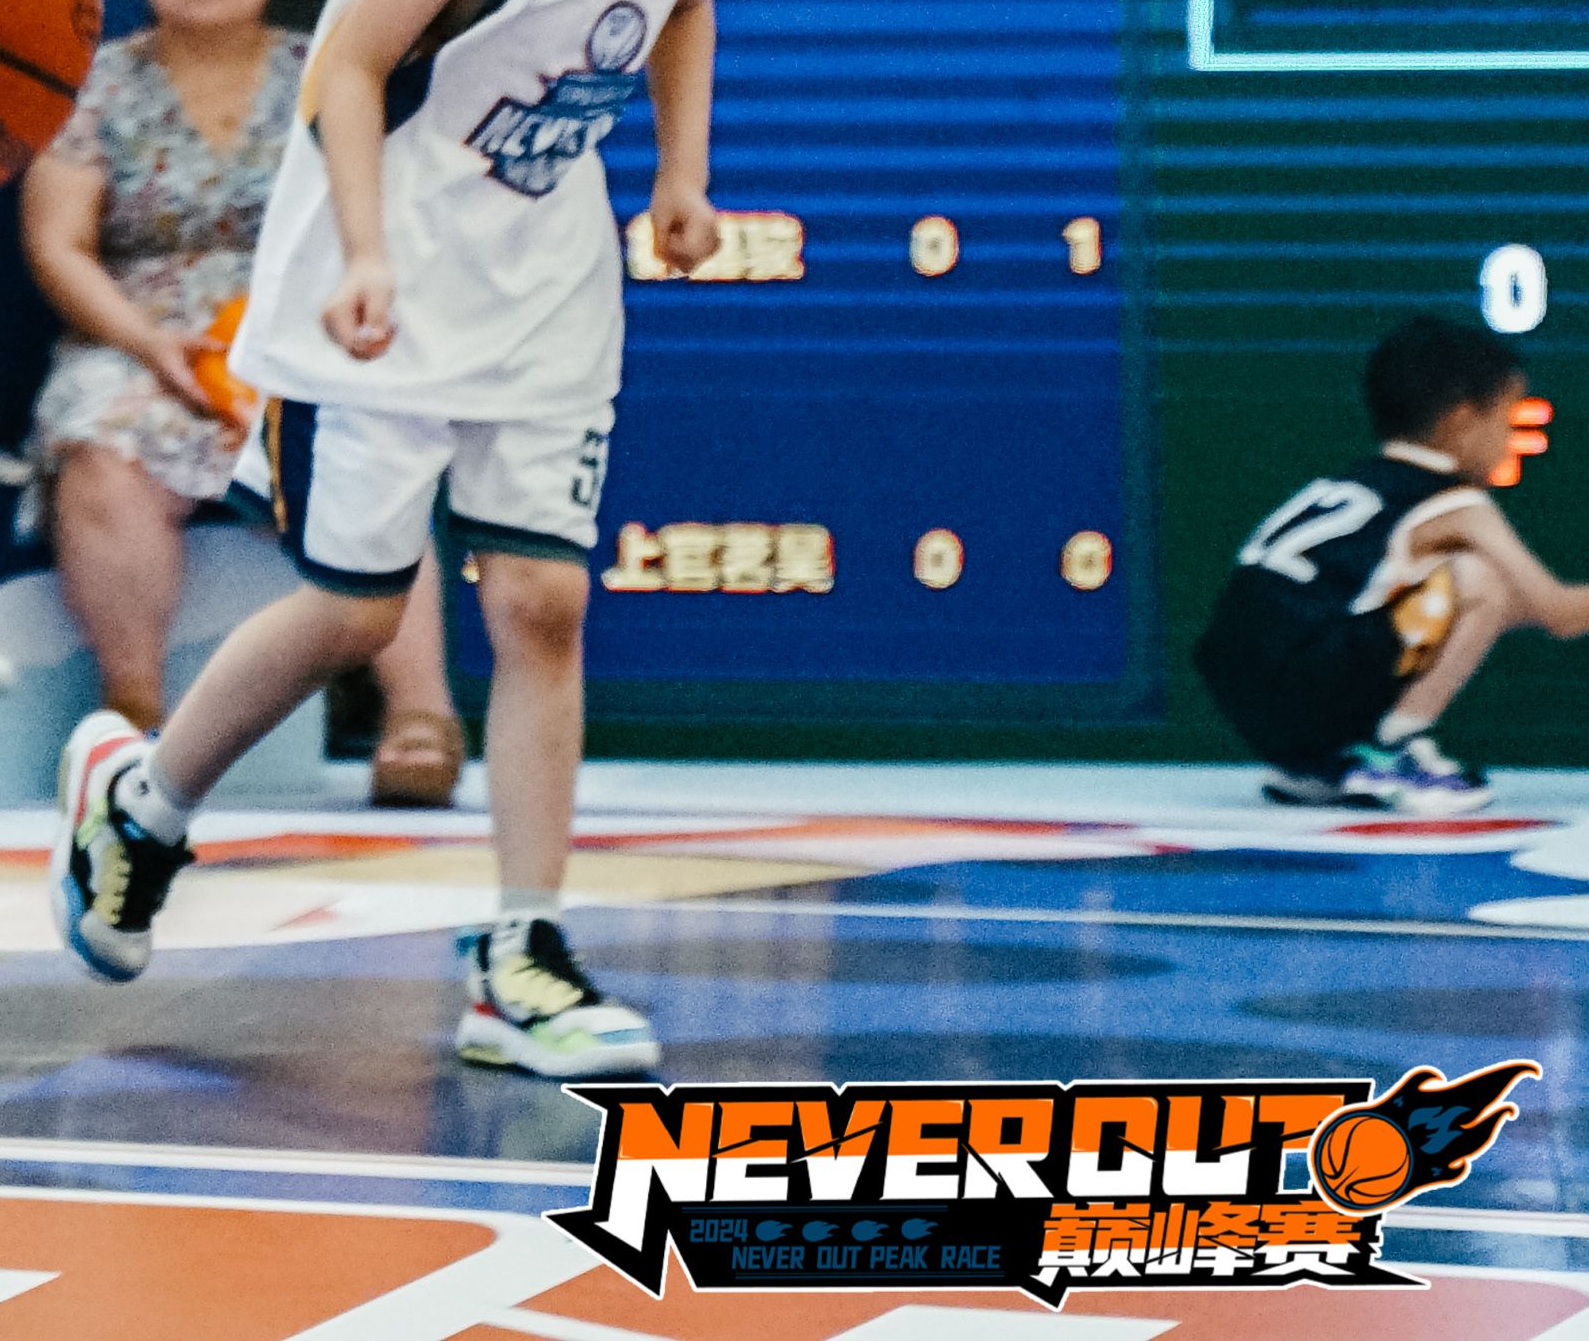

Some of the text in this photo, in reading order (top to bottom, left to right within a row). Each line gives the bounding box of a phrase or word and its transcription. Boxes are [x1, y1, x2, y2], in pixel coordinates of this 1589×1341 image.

[910, 215, 1101, 276] 0 1
[1480, 243, 1548, 334] 0
[914, 528, 963, 589] 0
